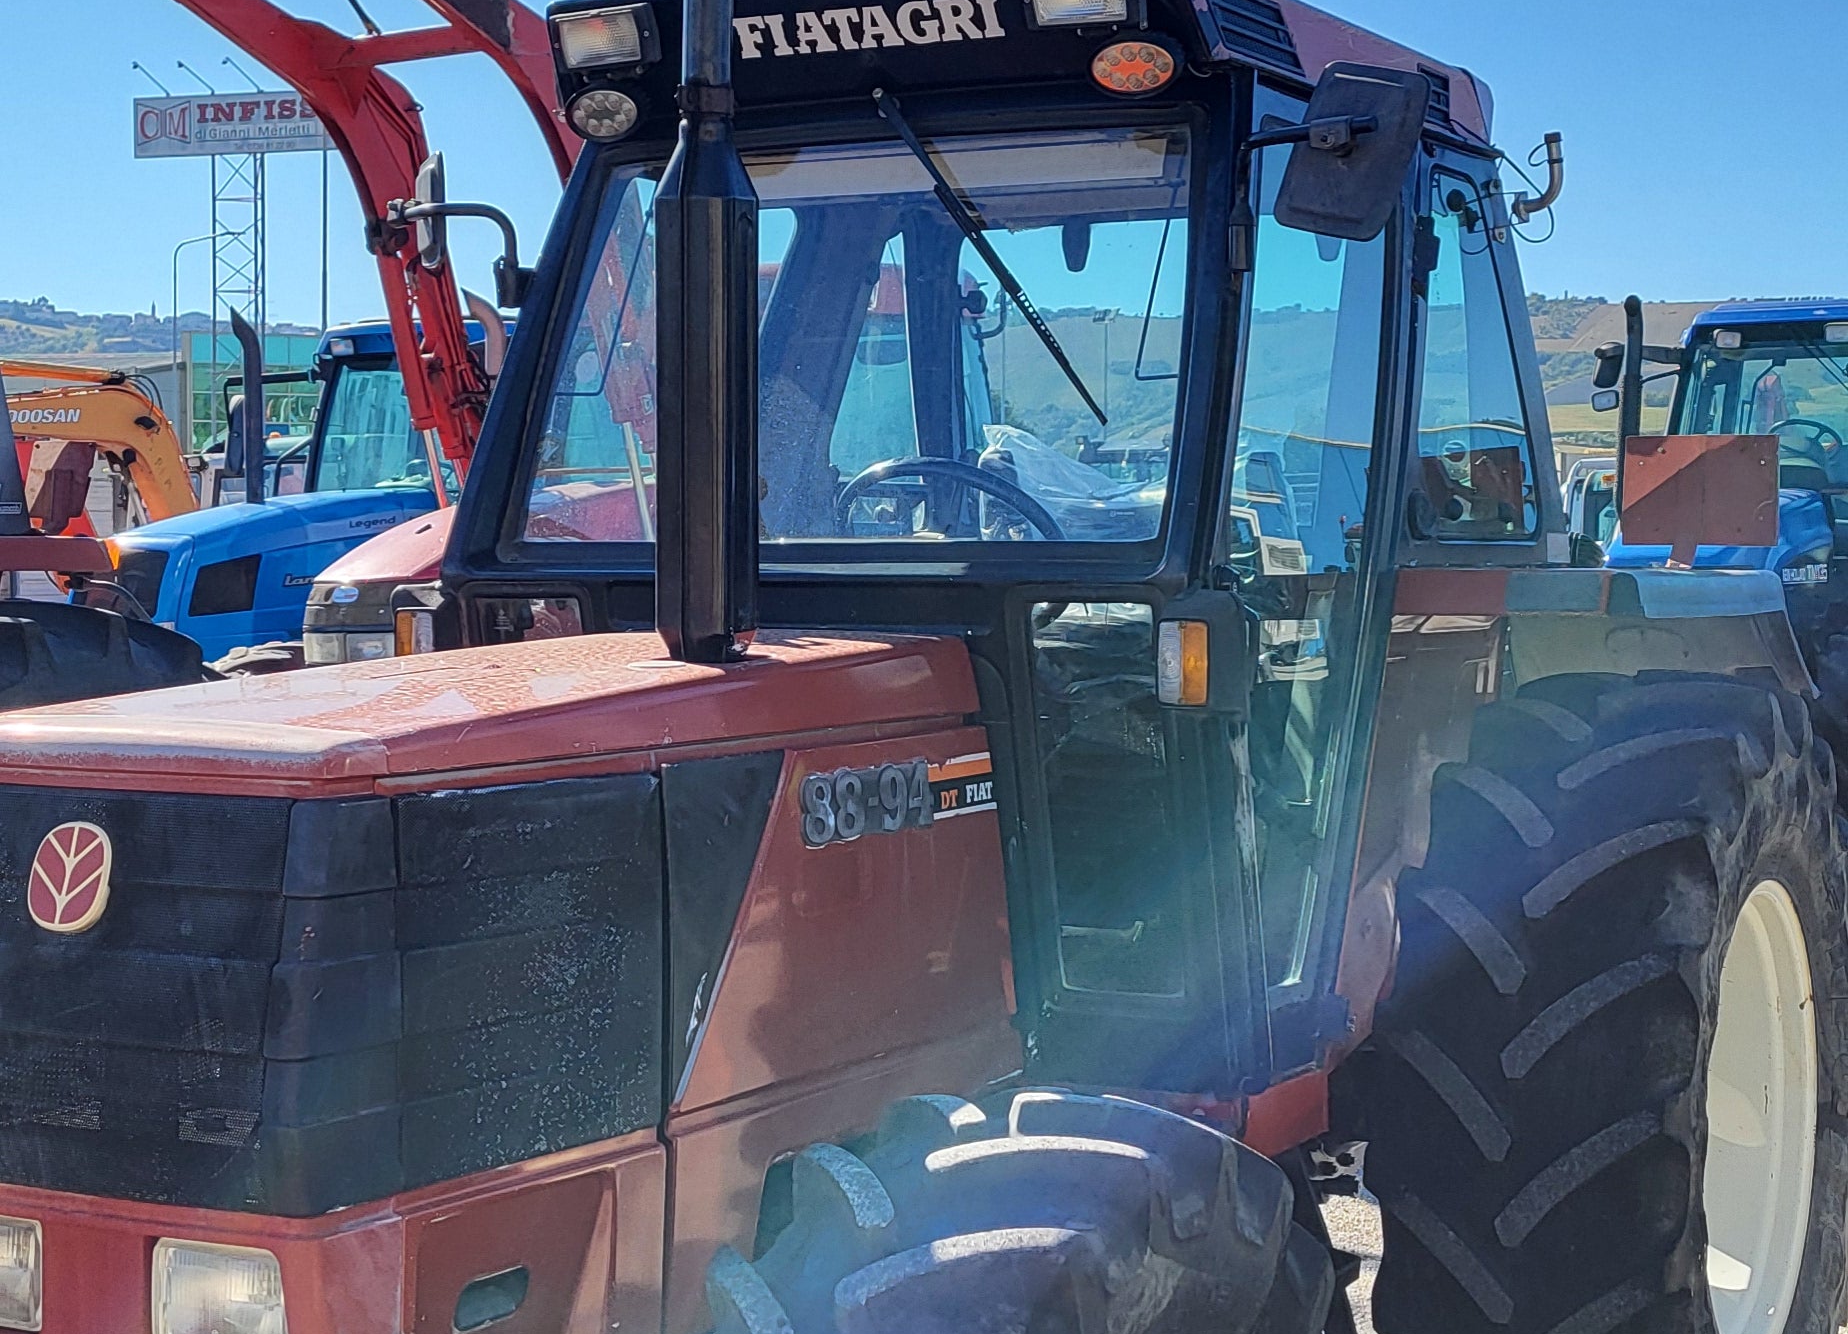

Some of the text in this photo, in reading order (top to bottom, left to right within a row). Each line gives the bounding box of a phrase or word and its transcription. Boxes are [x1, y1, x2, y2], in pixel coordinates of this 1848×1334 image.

[195, 122, 311, 140] di Gianni Merletti
[349, 516, 396, 528] Legend
[803, 760, 993, 846] 88-94 DT FIAT
